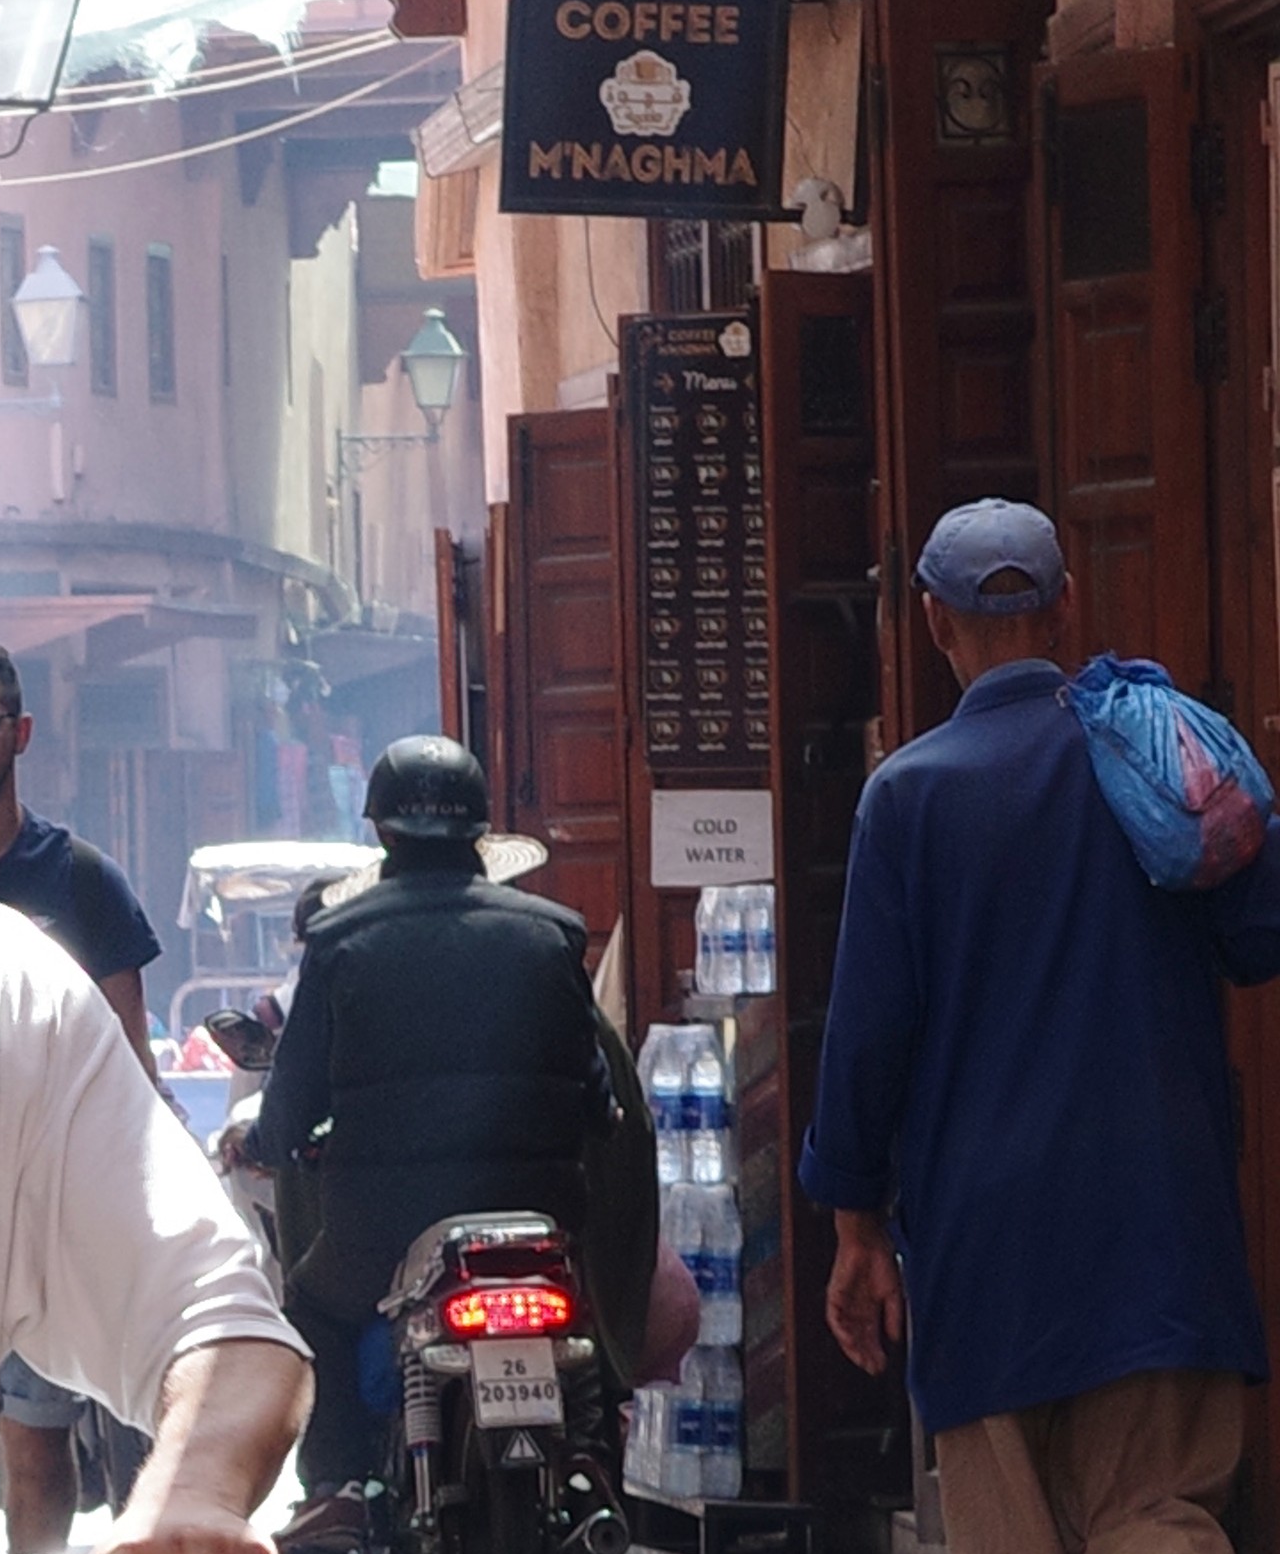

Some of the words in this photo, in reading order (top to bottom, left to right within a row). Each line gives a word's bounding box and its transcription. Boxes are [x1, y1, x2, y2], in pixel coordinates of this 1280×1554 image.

[555, 0, 740, 45] COFFEE
[528, 139, 757, 186] M'NAGHMA
[682, 370, 737, 390] Menu
[693, 819, 738, 835] COLD
[685, 847, 746, 863] WATER
[502, 1358, 526, 1376] 26
[481, 1383, 555, 1403] 203940
